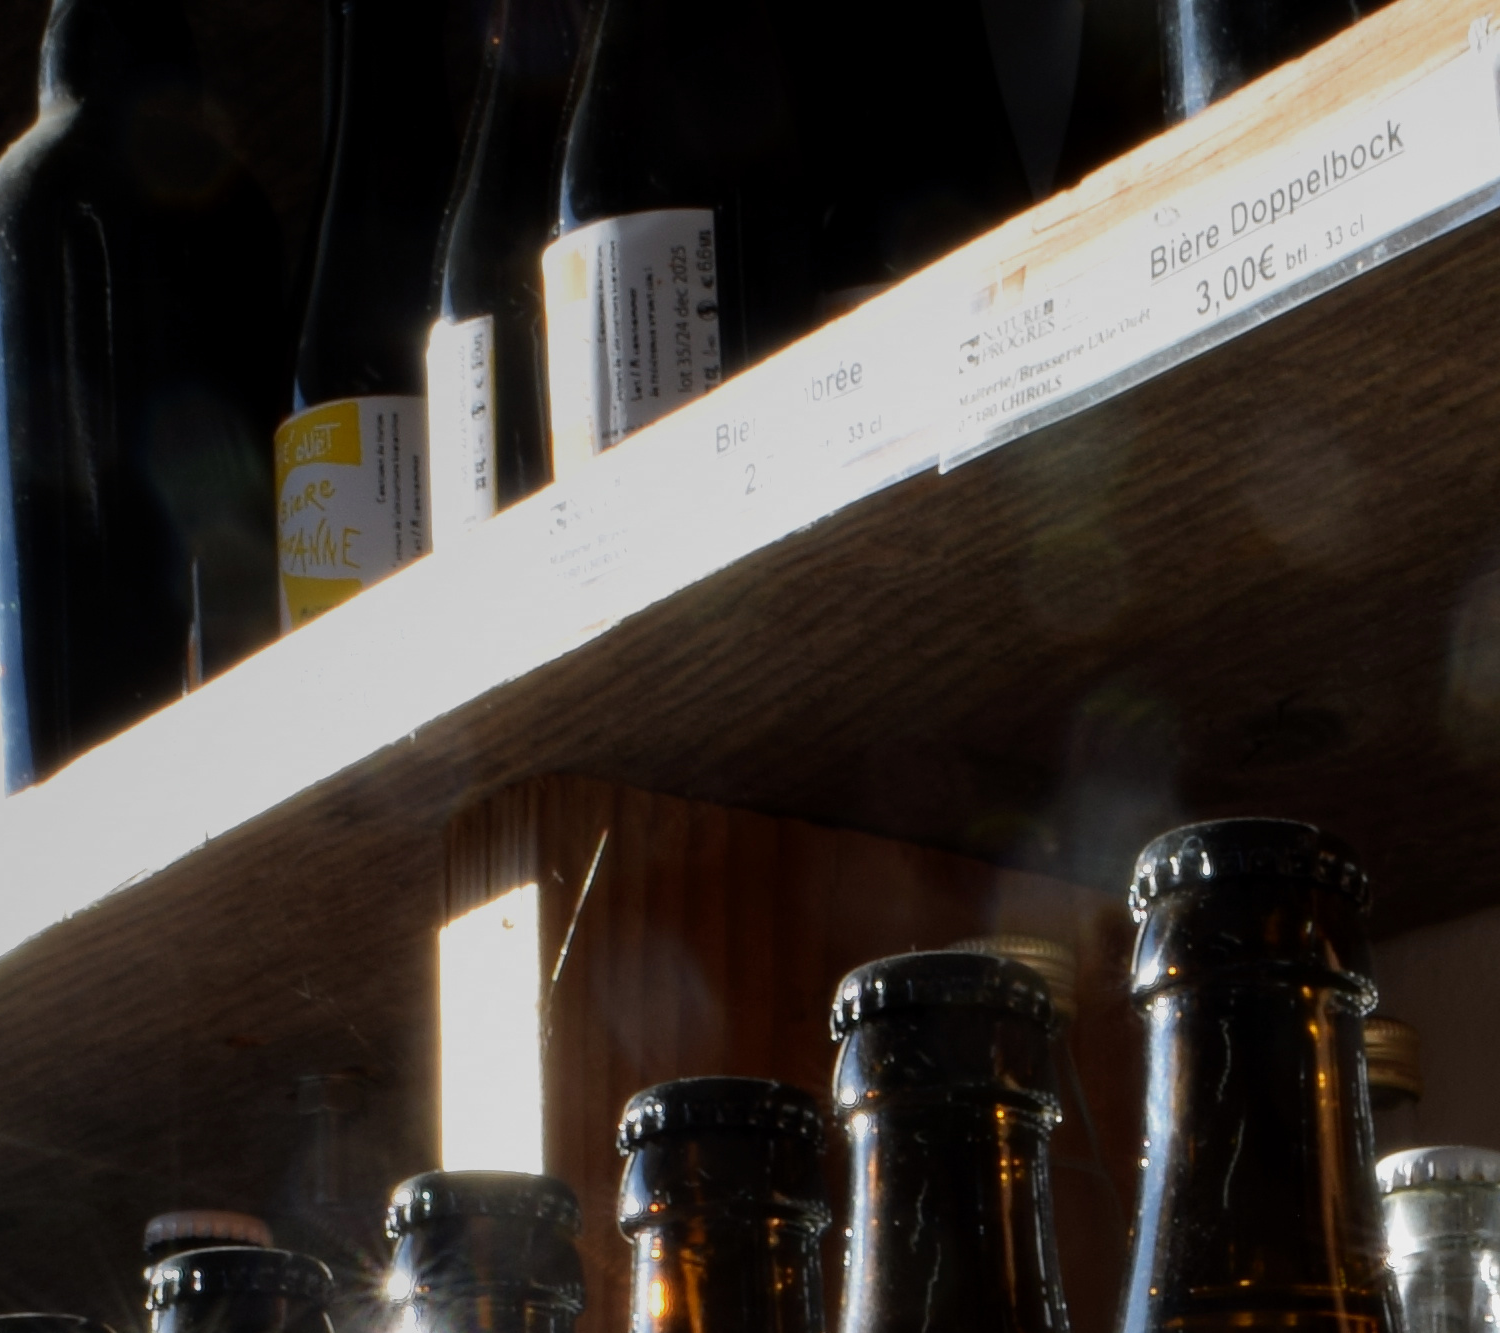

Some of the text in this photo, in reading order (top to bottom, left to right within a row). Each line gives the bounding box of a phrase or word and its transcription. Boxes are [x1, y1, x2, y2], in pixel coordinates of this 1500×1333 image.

[1149, 119, 1404, 281] Bière Doppelbock
[671, 245, 688, 285] 2025
[1196, 214, 1365, 317] 3,00€ btl 33 cl
[673, 288, 689, 318] dec
[1001, 375, 1062, 411] CHIROLS
[848, 415, 882, 443] 33 cl
